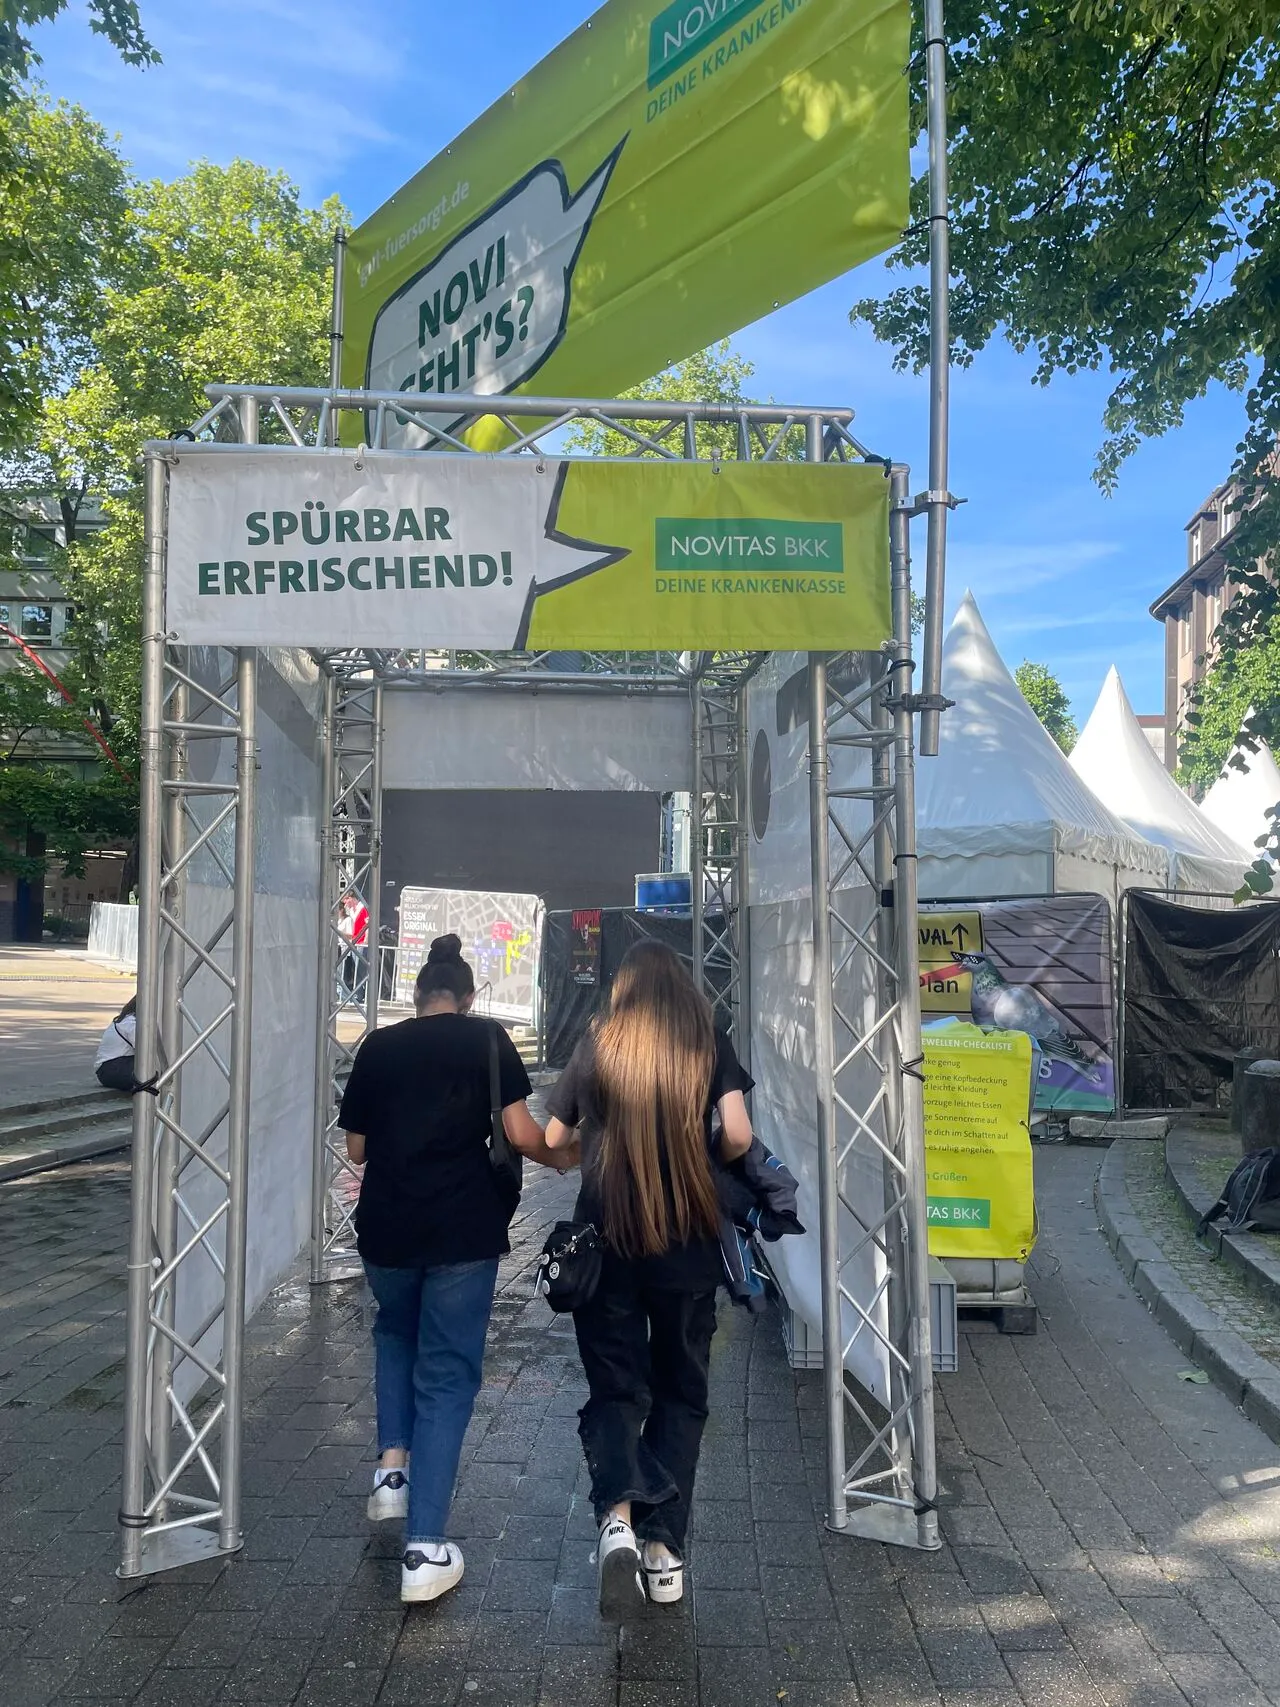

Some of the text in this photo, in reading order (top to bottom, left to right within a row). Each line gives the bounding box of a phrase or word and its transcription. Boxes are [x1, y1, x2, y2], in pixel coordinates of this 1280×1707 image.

[663, 0, 738, 58] NOV
[646, 0, 803, 123] DEINE KRANKEN
[418, 235, 506, 348] NOVI
[246, 500, 453, 546] SPÜRBAR
[671, 535, 830, 559] NOVITAS BKK
[198, 551, 512, 596] ERFRISCHEND!
[655, 578, 847, 595] DEINE KRANKENKASSE
[403, 910, 426, 921] ESSEN
[403, 921, 438, 932] ORIGINAL
[937, 1060, 961, 1069] genug
[953, 1074, 1008, 1087] Kopfbedeckung
[954, 1099, 981, 1108] leichtes
[982, 1101, 1002, 1109] Essen
[934, 1114, 986, 1124] Sonnencreme
[986, 1116, 998, 1124] auf
[933, 1128, 951, 1137] dich
[951, 1129, 963, 1137] im
[963, 1129, 996, 1139] Schatten
[997, 1132, 1009, 1140] auf
[953, 1207, 981, 1221] BKK
[608, 1526, 625, 1537] NIKE
[658, 1576, 674, 1586] NIKE
